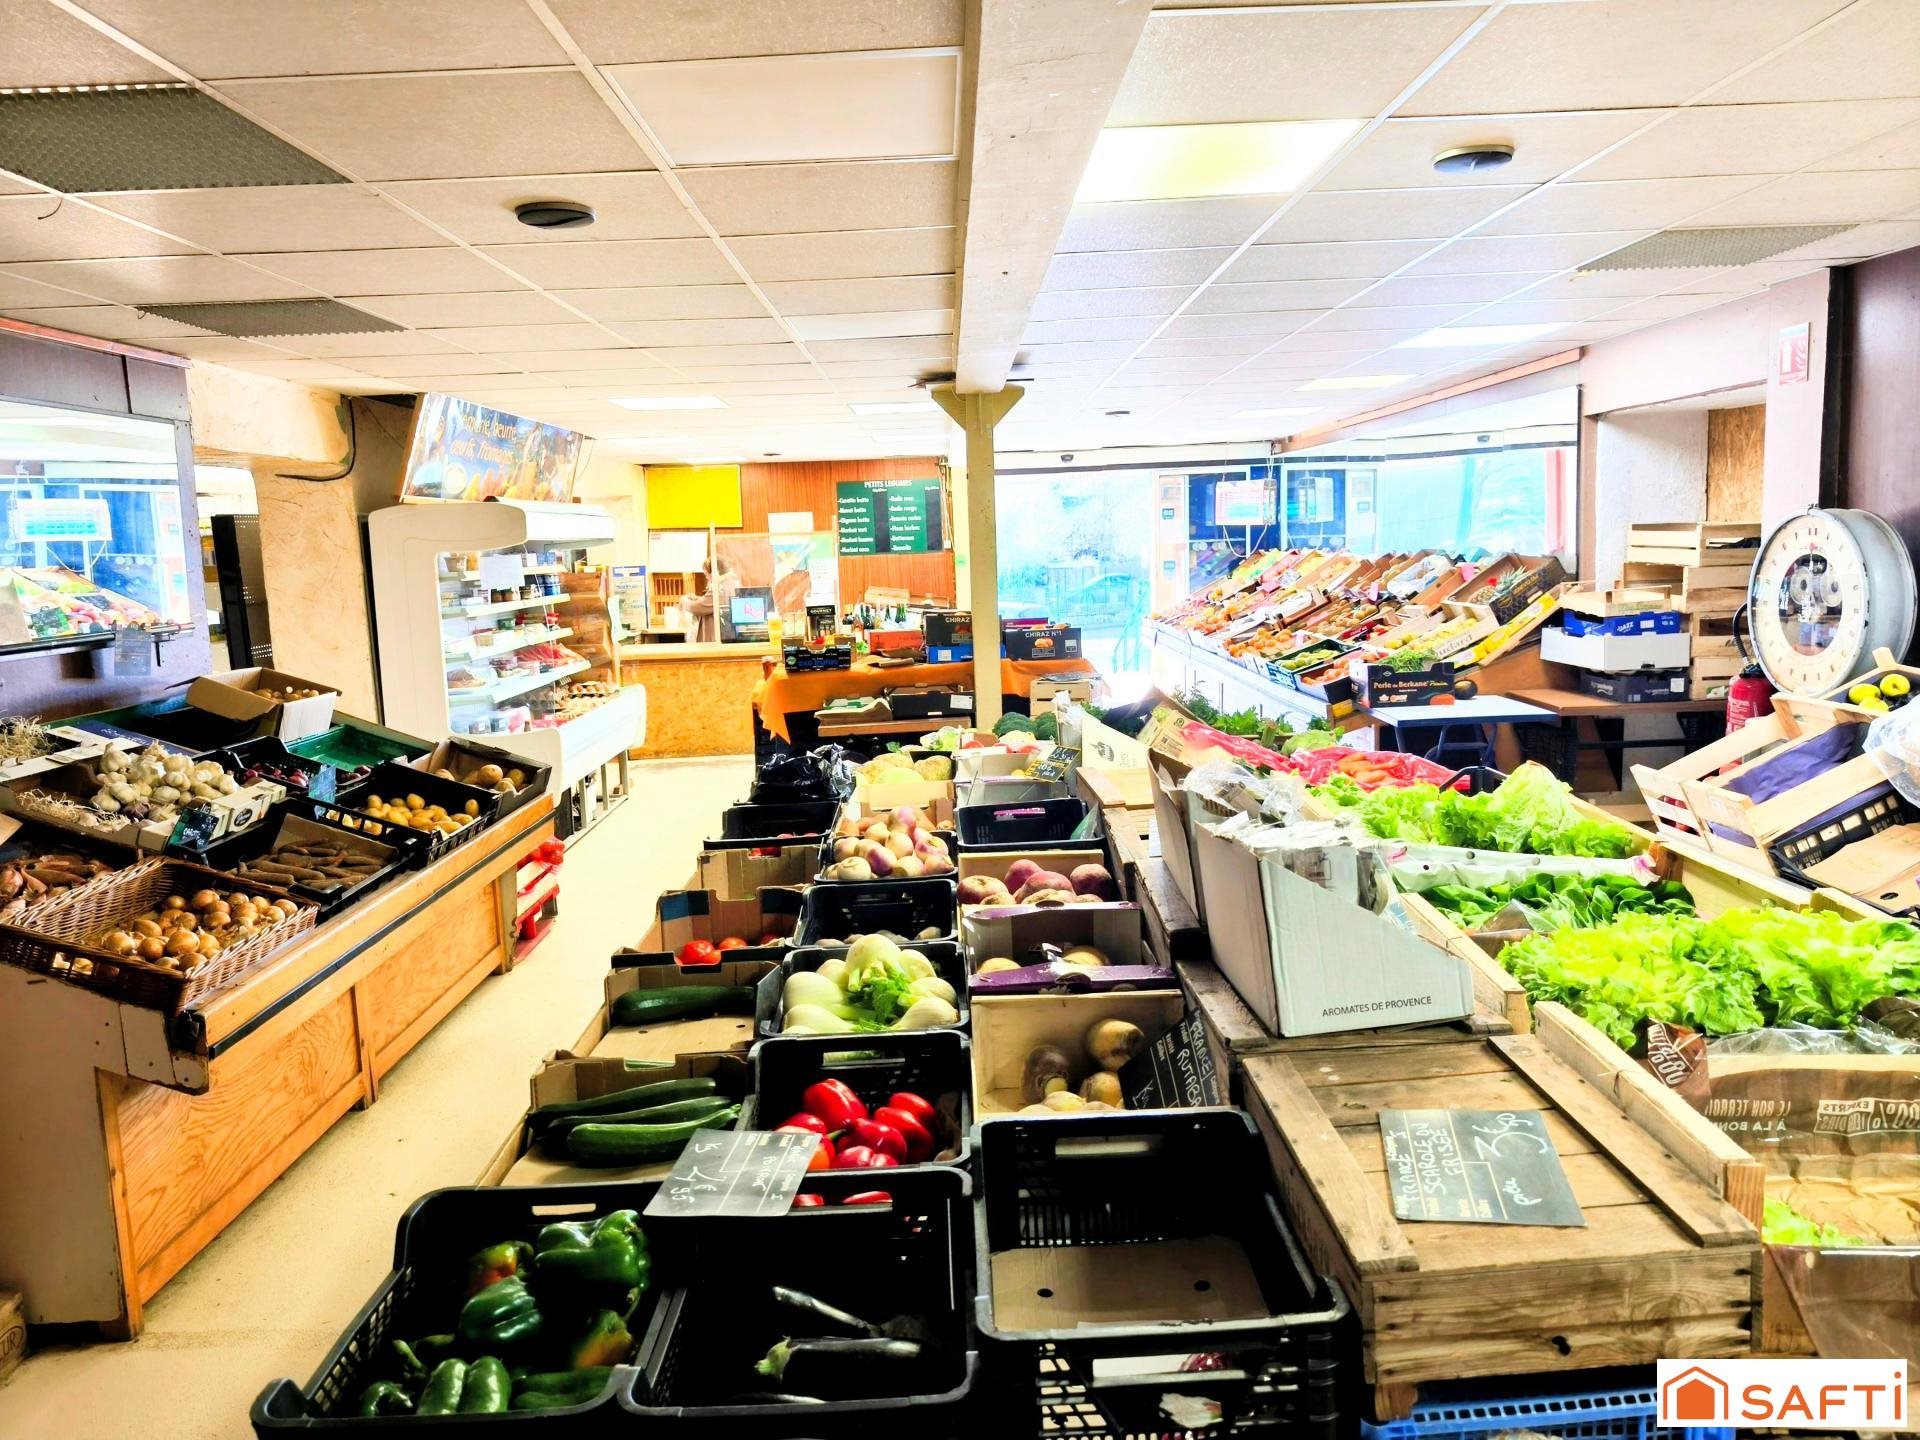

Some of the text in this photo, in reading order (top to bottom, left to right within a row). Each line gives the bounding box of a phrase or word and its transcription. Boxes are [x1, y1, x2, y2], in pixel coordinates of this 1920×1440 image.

[1322, 996, 1432, 1017] AROMATES DE PROVENCE
[1398, 1153, 1421, 1201] FRANCE
[1414, 1135, 1447, 1195] SCAROLE
